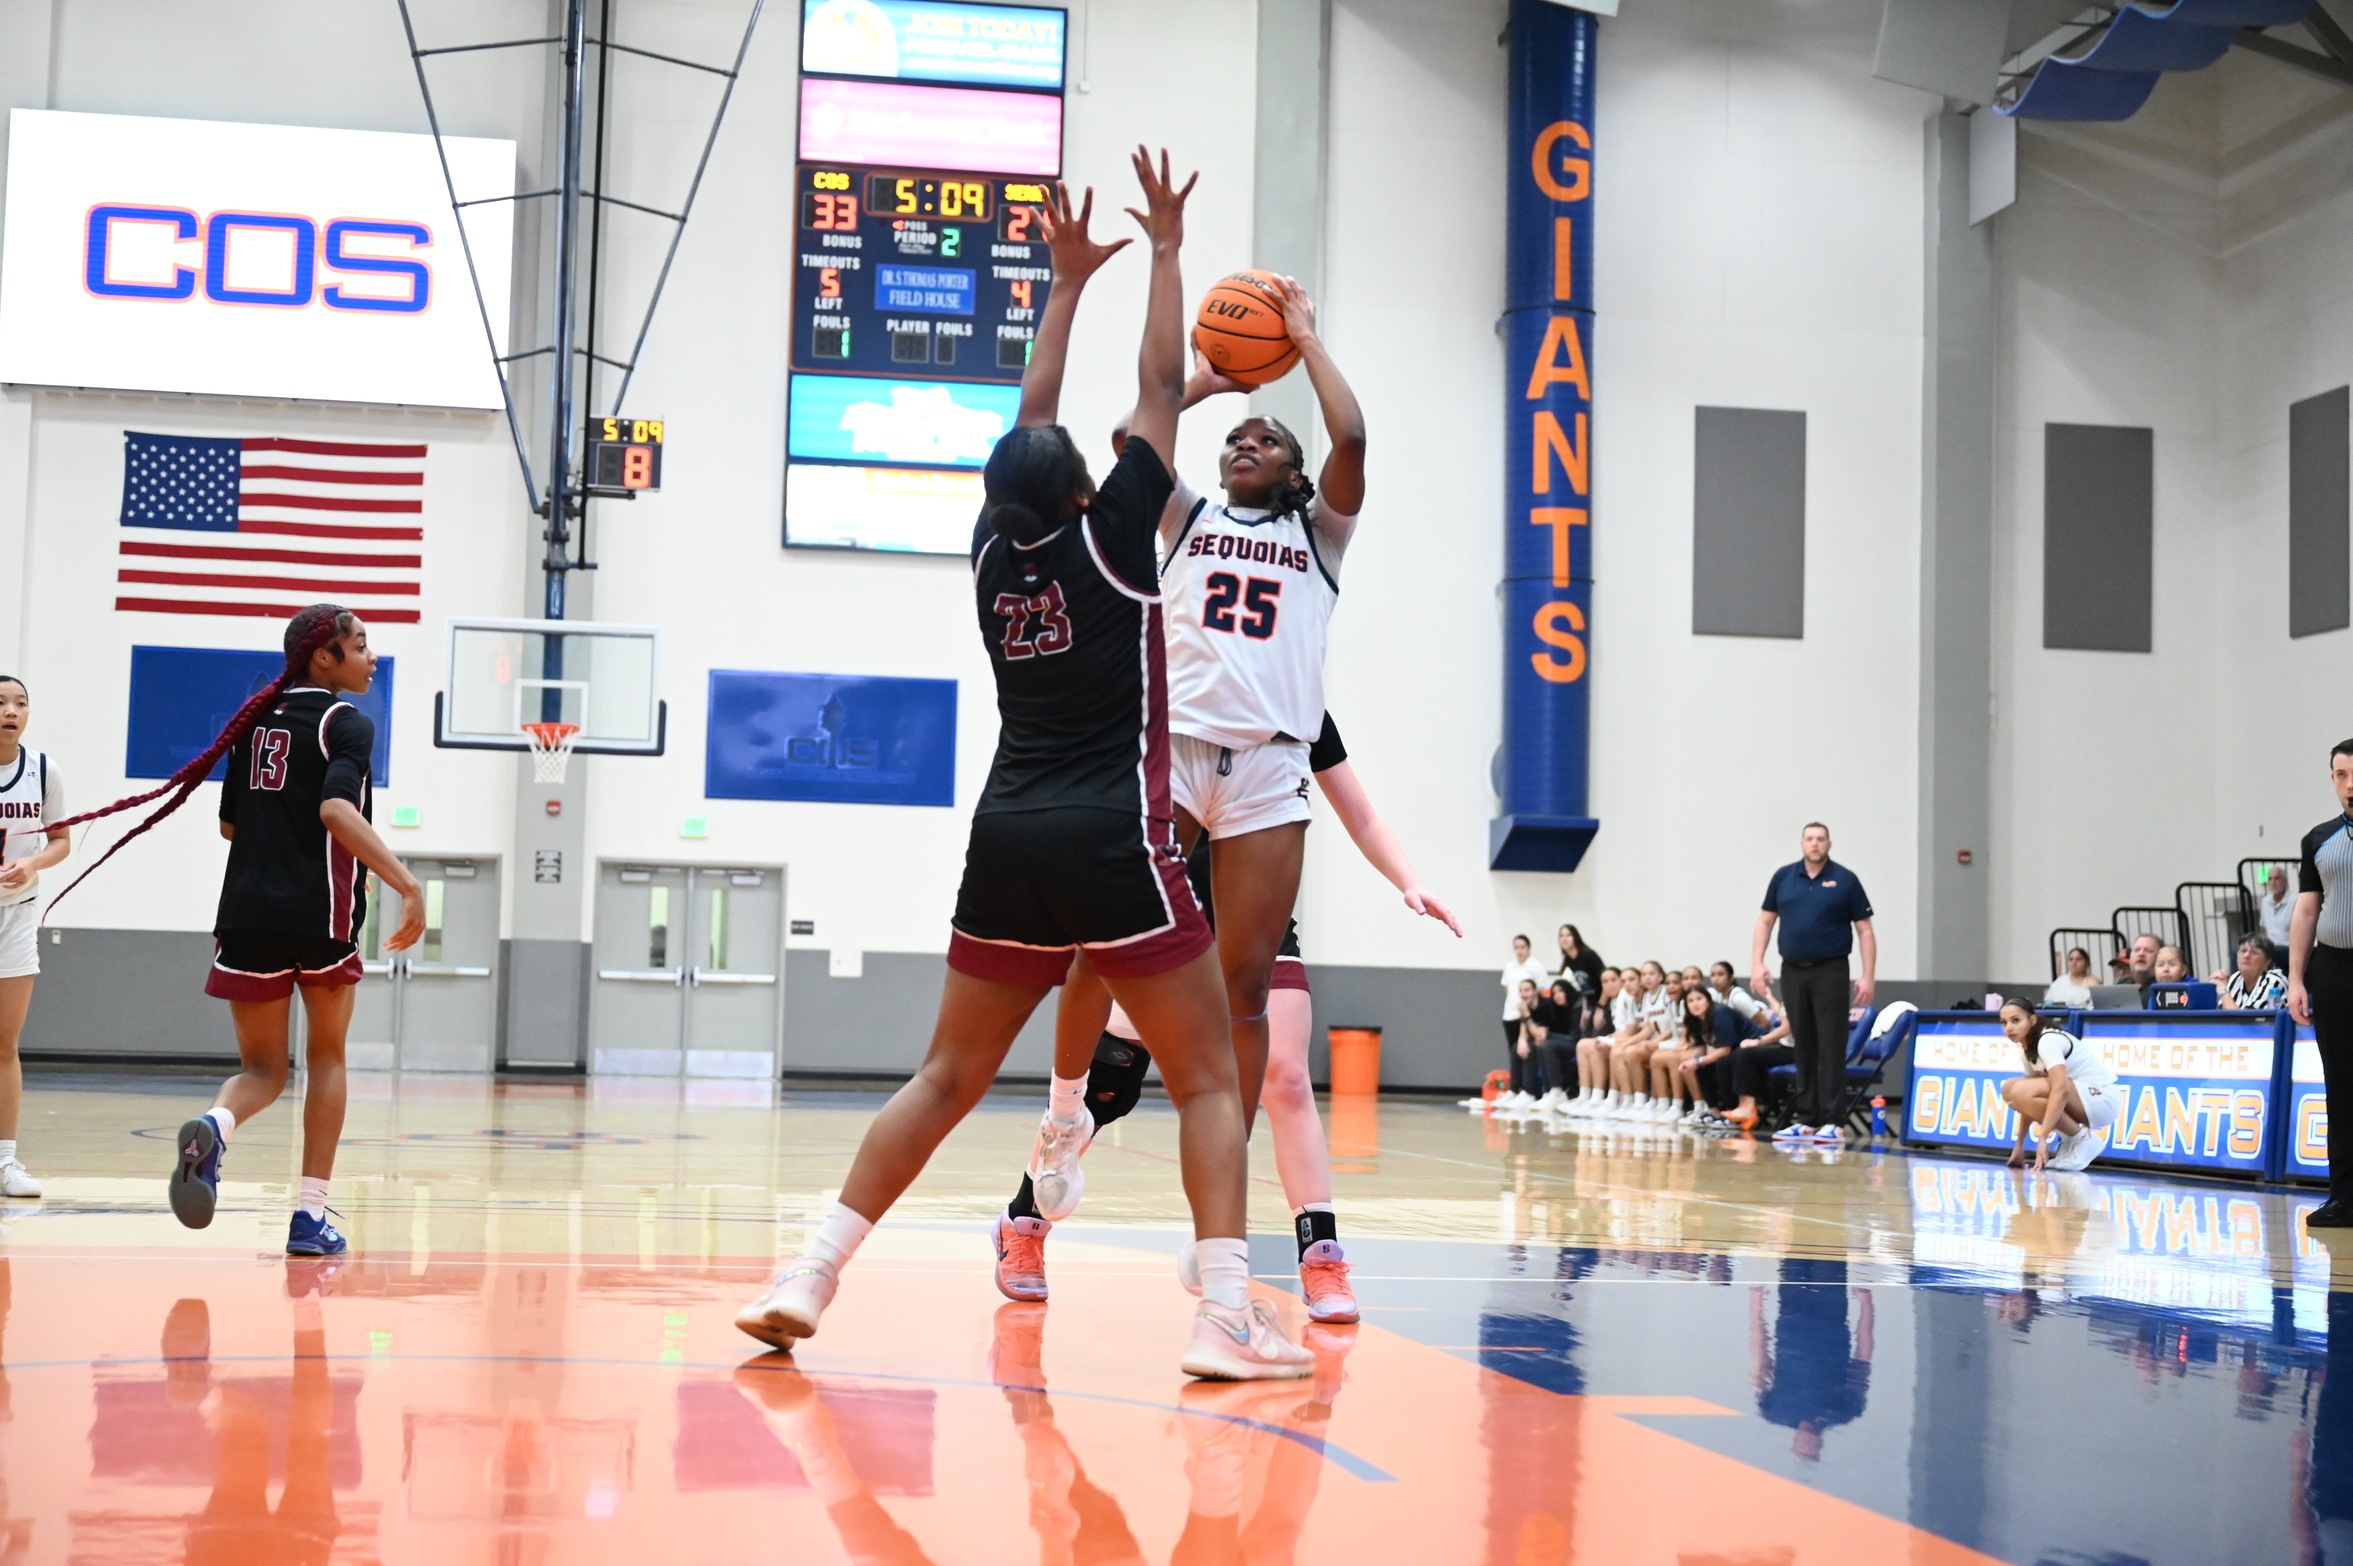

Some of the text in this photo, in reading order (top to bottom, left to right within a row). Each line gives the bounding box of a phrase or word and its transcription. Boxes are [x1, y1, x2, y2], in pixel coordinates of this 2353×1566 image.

[967, 18, 1058, 42] TODAY!
[813, 172, 850, 190] COS
[896, 178, 984, 218] 5:09
[813, 193, 858, 231] 33
[822, 234, 862, 249] BONUS
[894, 231, 938, 246] PERIOD
[942, 228, 960, 256] 2
[82, 202, 433, 316] COS
[801, 254, 861, 270] TIMEOUTS
[991, 244, 1031, 259] BONUS
[820, 268, 840, 297] 5
[992, 265, 1051, 282] TIMEOUTS
[814, 297, 843, 311] LEFT
[889, 289, 961, 309] FIELD HOUSE
[1011, 281, 1031, 308] 4
[813, 315, 850, 329] FOULS
[1006, 308, 1035, 321] LEFT
[1207, 300, 1249, 320] EVO
[886, 319, 973, 336] PLAYER FOULS
[997, 325, 1034, 339] FOULS
[1525, 120, 1591, 684] GIANTS
[603, 418, 664, 444] 5:09
[624, 446, 651, 489] 8
[1187, 534, 1309, 573] SEQUOIAS
[1202, 571, 1281, 641] 25
[993, 580, 1073, 660] 23
[250, 726, 292, 791] 13
[0, 803, 41, 819] OIAS
[1934, 1041, 1981, 1063] HOME
[1989, 1043, 2009, 1064] OF
[2103, 1044, 2250, 1071] HOME OF THE
[1913, 1075, 2056, 1143] GIAN
[2094, 1085, 2264, 1159] IANTS
